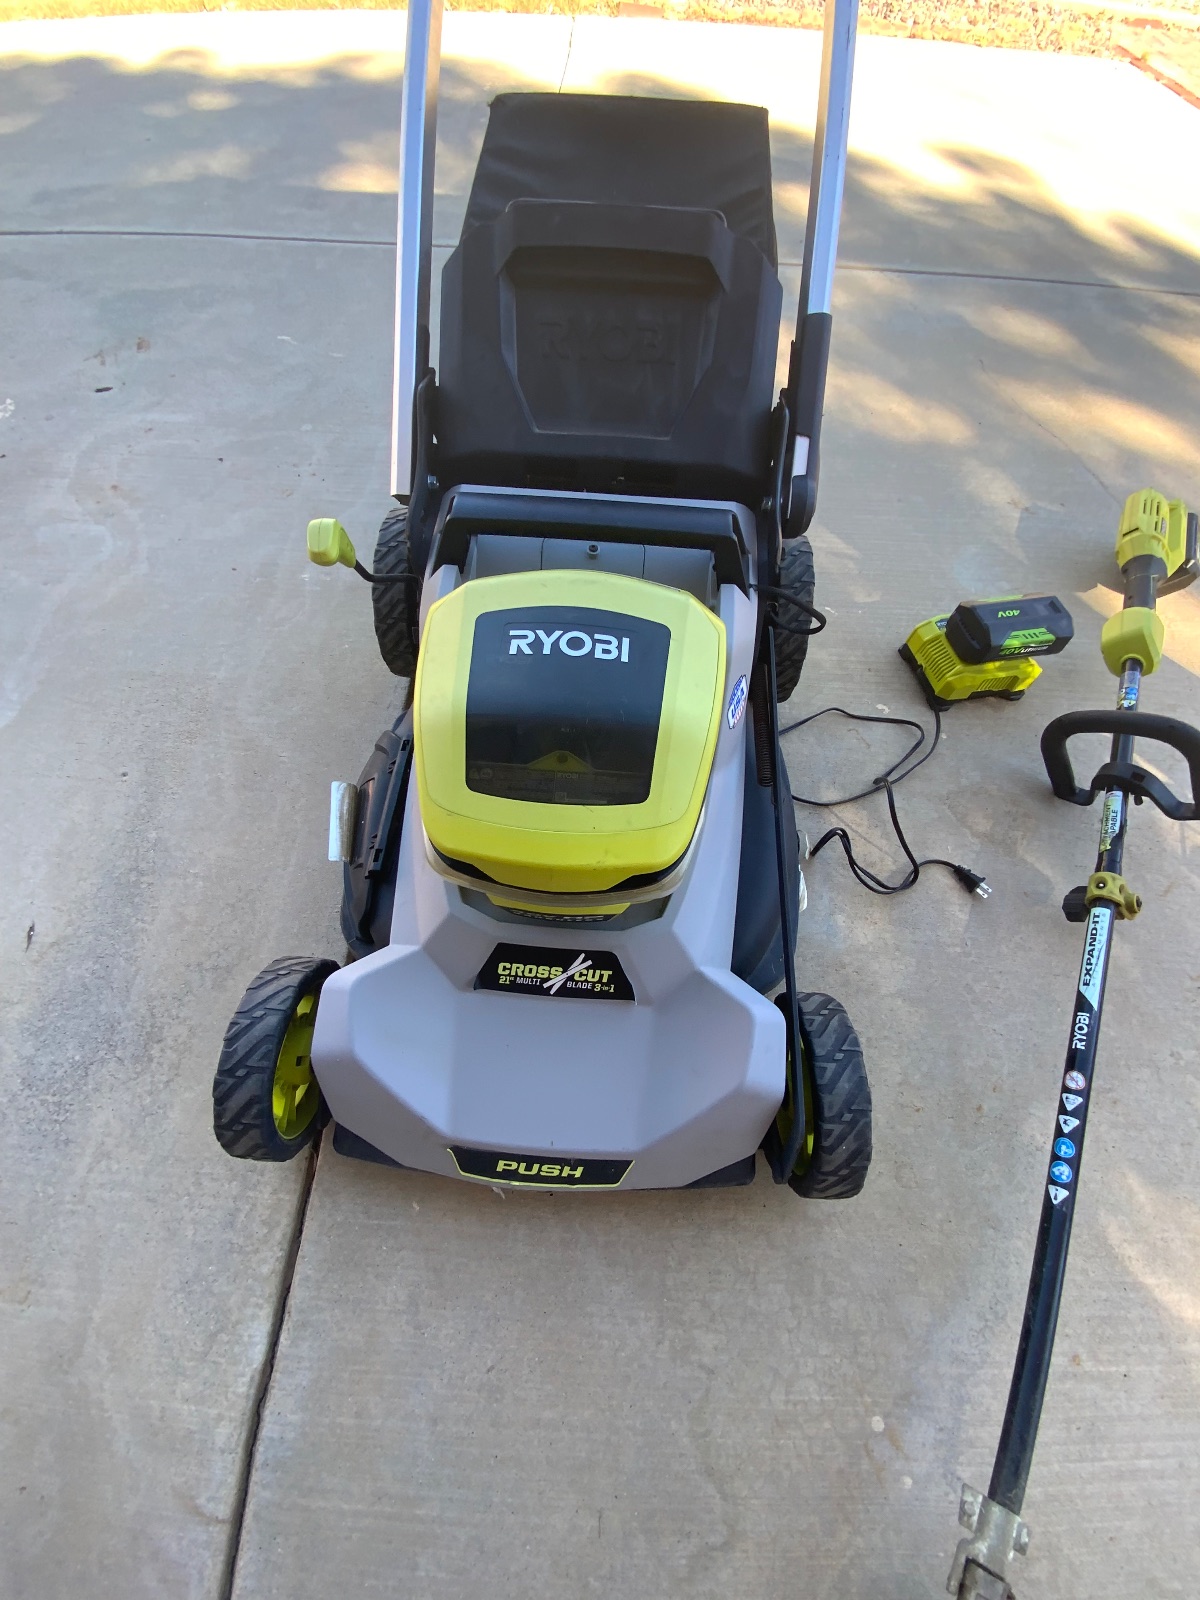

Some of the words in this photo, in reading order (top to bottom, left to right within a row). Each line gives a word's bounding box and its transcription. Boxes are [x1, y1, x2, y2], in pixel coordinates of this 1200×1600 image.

[998, 609, 1020, 618] 40V
[508, 629, 630, 662] RYOBI
[1110, 809, 1118, 836] APABLE
[497, 962, 564, 979] CROSS
[573, 969, 613, 983] CUT
[515, 978, 541, 986] MULTI
[566, 981, 593, 990] BLADE
[1072, 1012, 1090, 1050] RYOBI
[496, 1159, 584, 1178] PUSH
